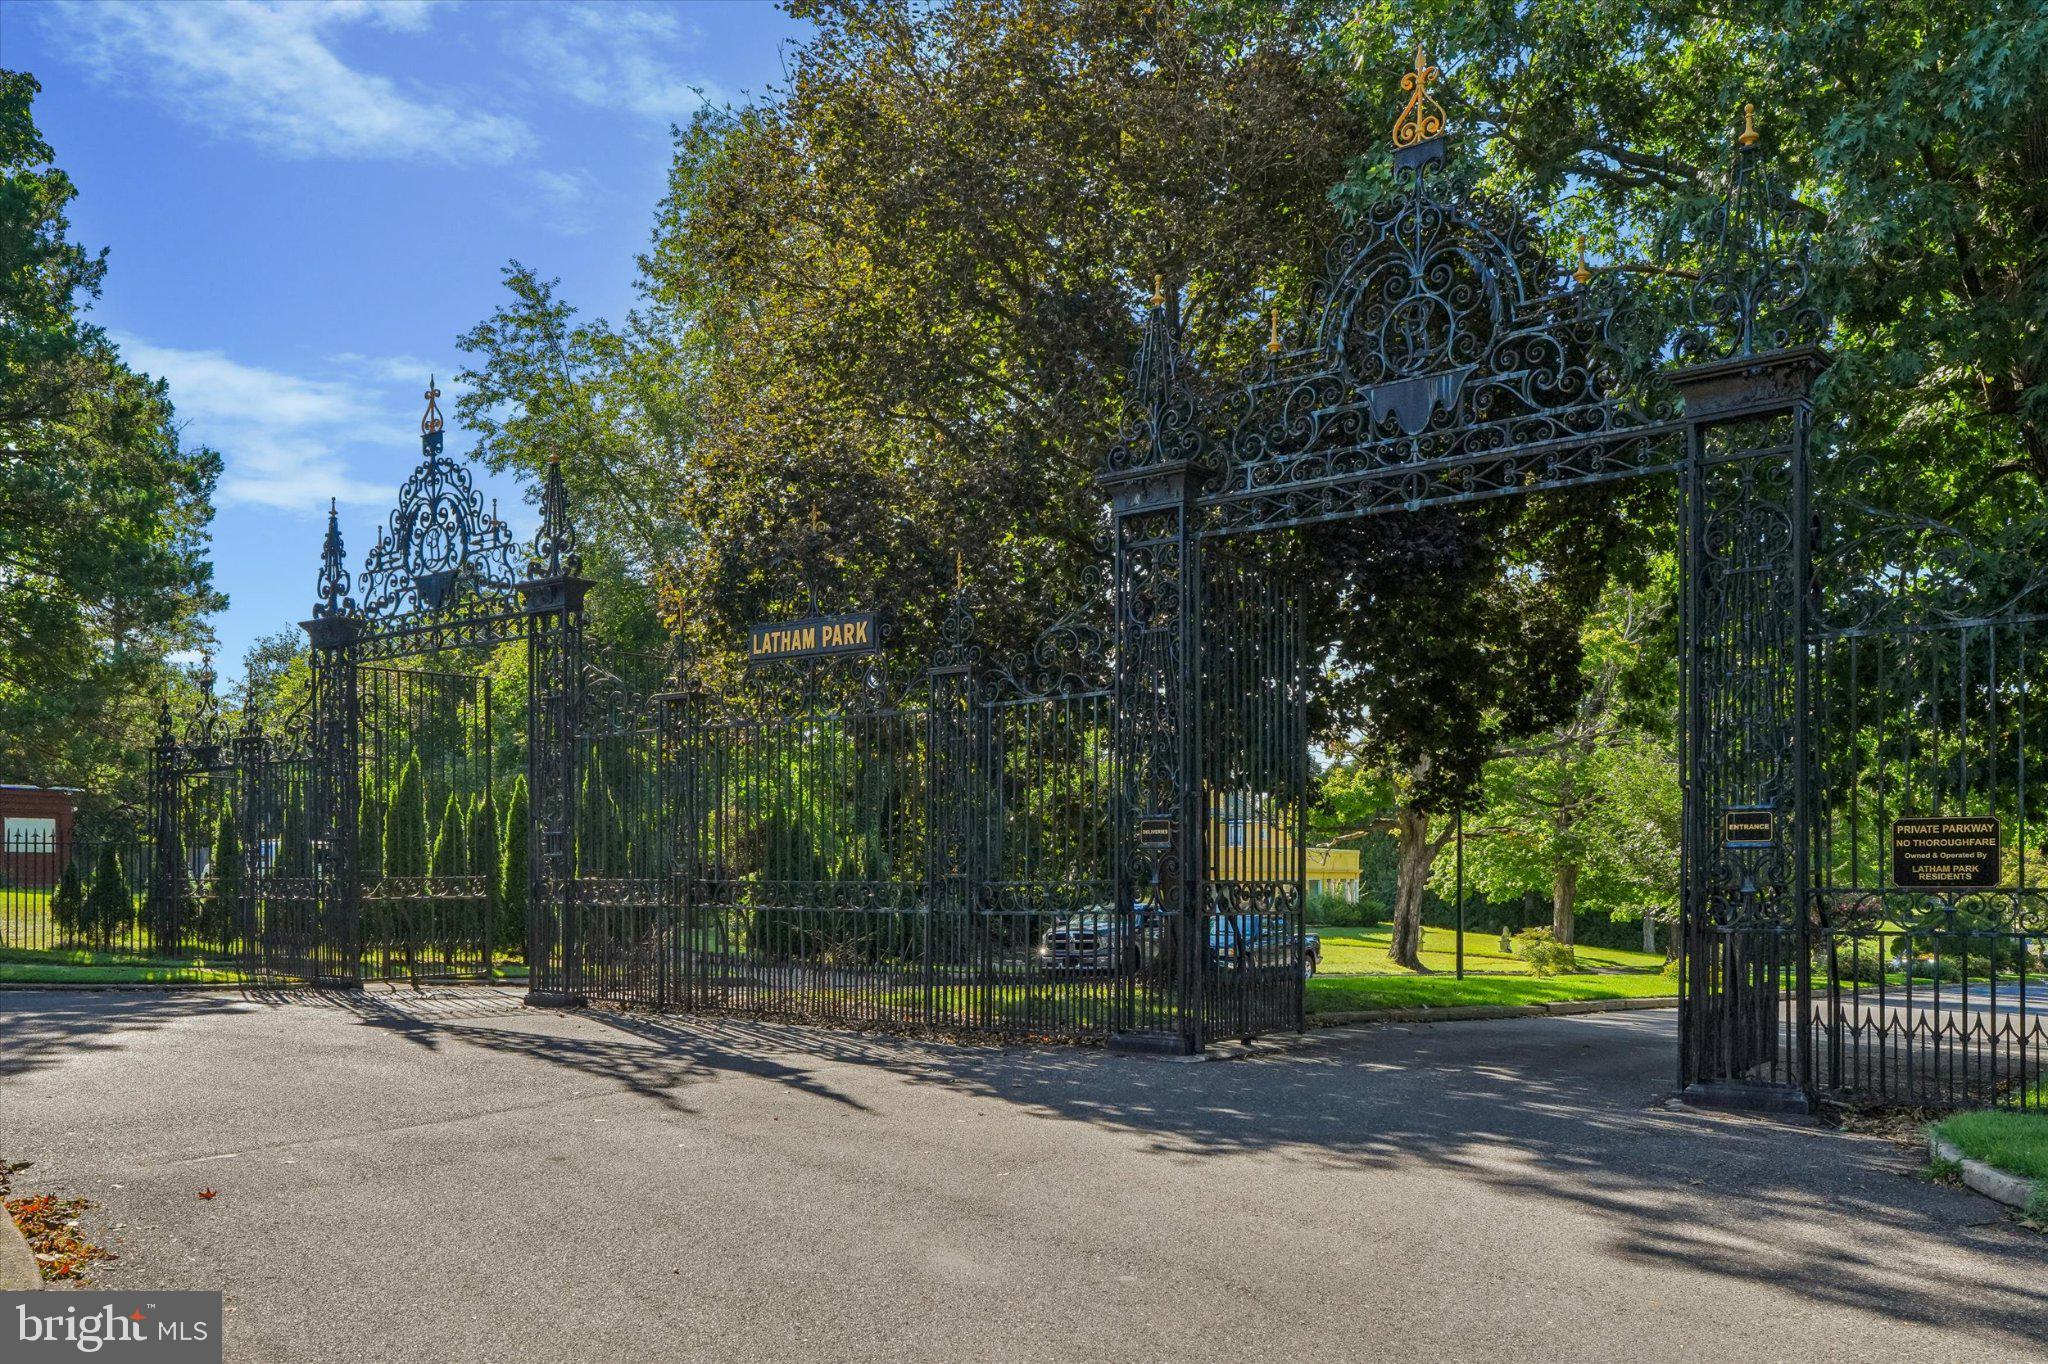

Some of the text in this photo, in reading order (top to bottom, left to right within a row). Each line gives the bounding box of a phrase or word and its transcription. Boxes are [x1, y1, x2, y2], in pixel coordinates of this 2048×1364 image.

[753, 620, 868, 655] LATHAM PARK
[1897, 824, 1994, 834] PRIVATE PARKWAY
[1896, 838, 1996, 847] NO THOROUGHFARE
[1940, 852, 1975, 860] Operated
[1976, 851, 1987, 859] By
[1912, 865, 1951, 873] LATHAM
[1919, 872, 1972, 880] RESIDENTS
